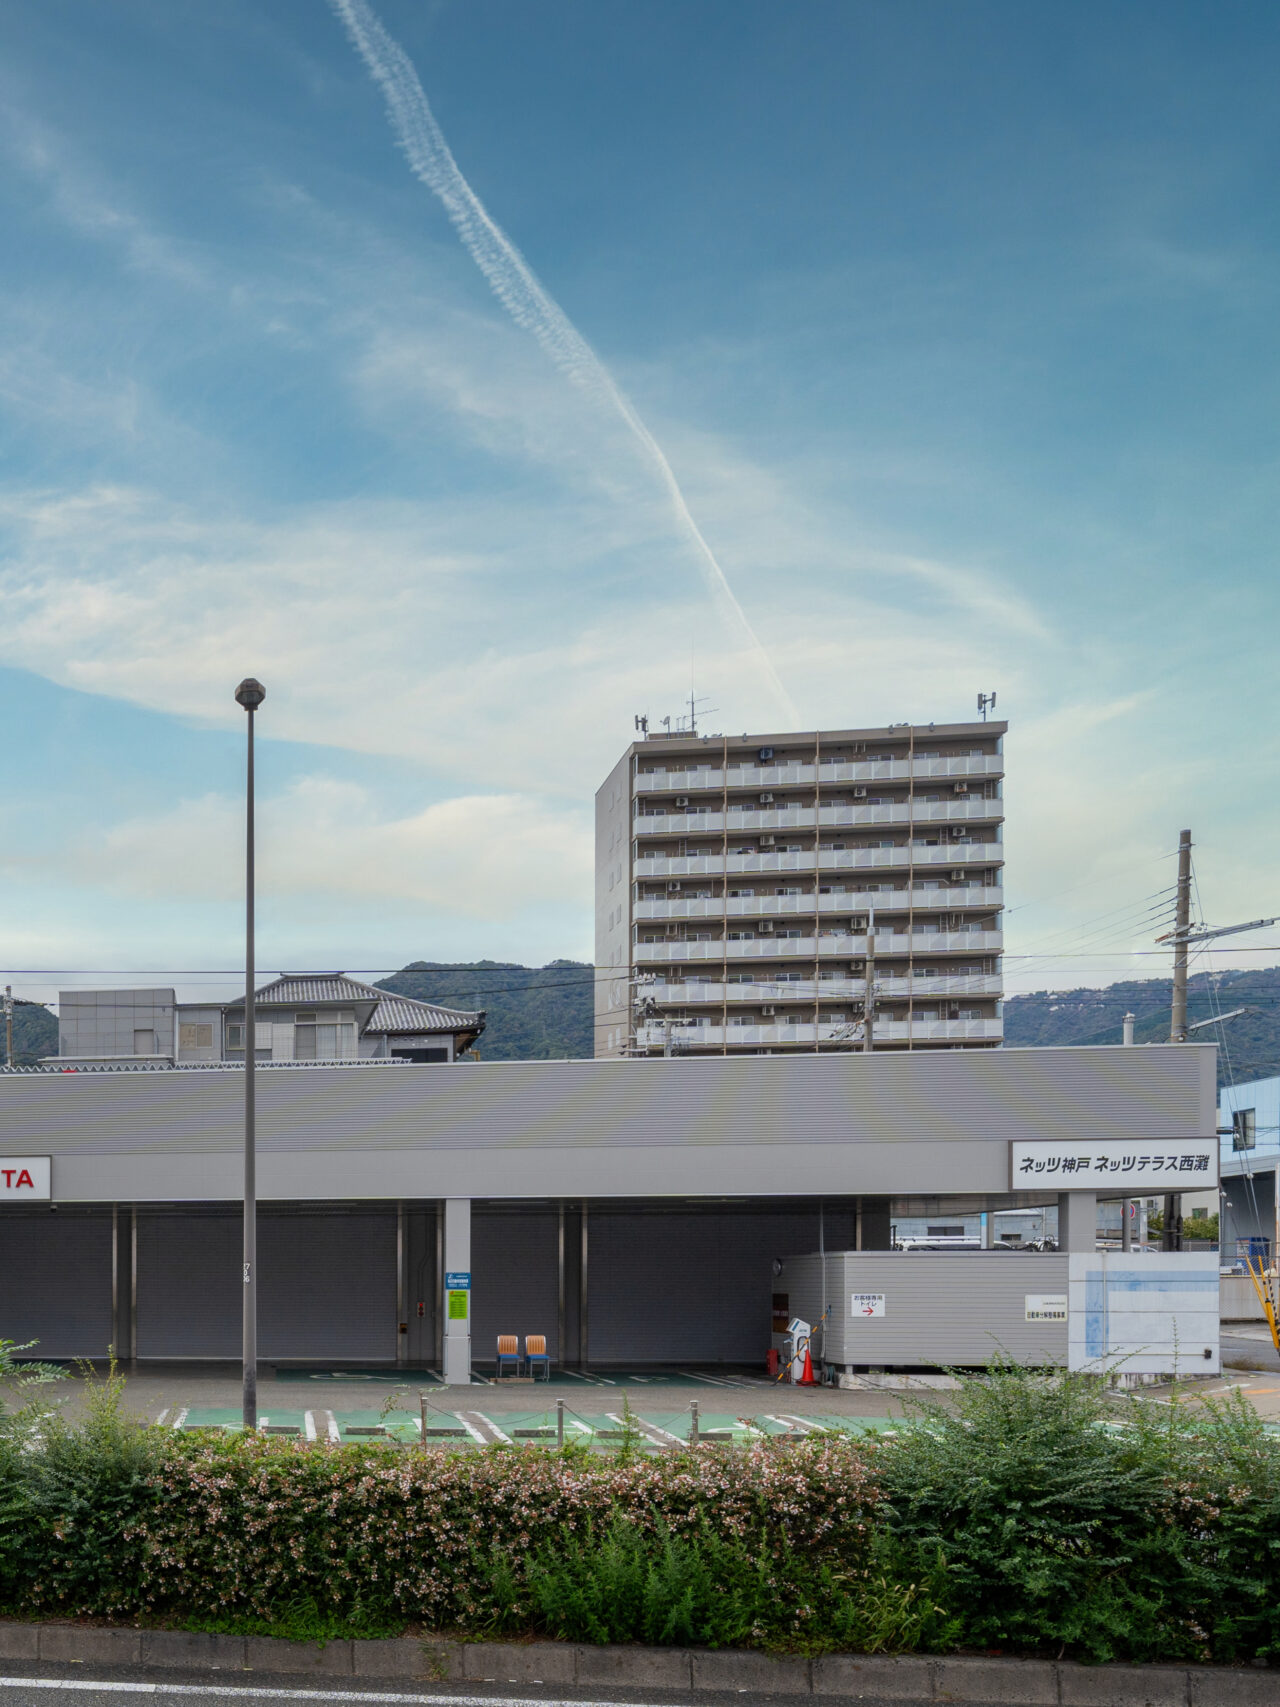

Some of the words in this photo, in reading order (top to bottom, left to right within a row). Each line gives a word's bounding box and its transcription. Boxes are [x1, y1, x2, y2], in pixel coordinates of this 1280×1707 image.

[1019, 1155, 1091, 1174] ネッツ神戸
[1094, 1153, 1210, 1173] ネッツテラス西灘
